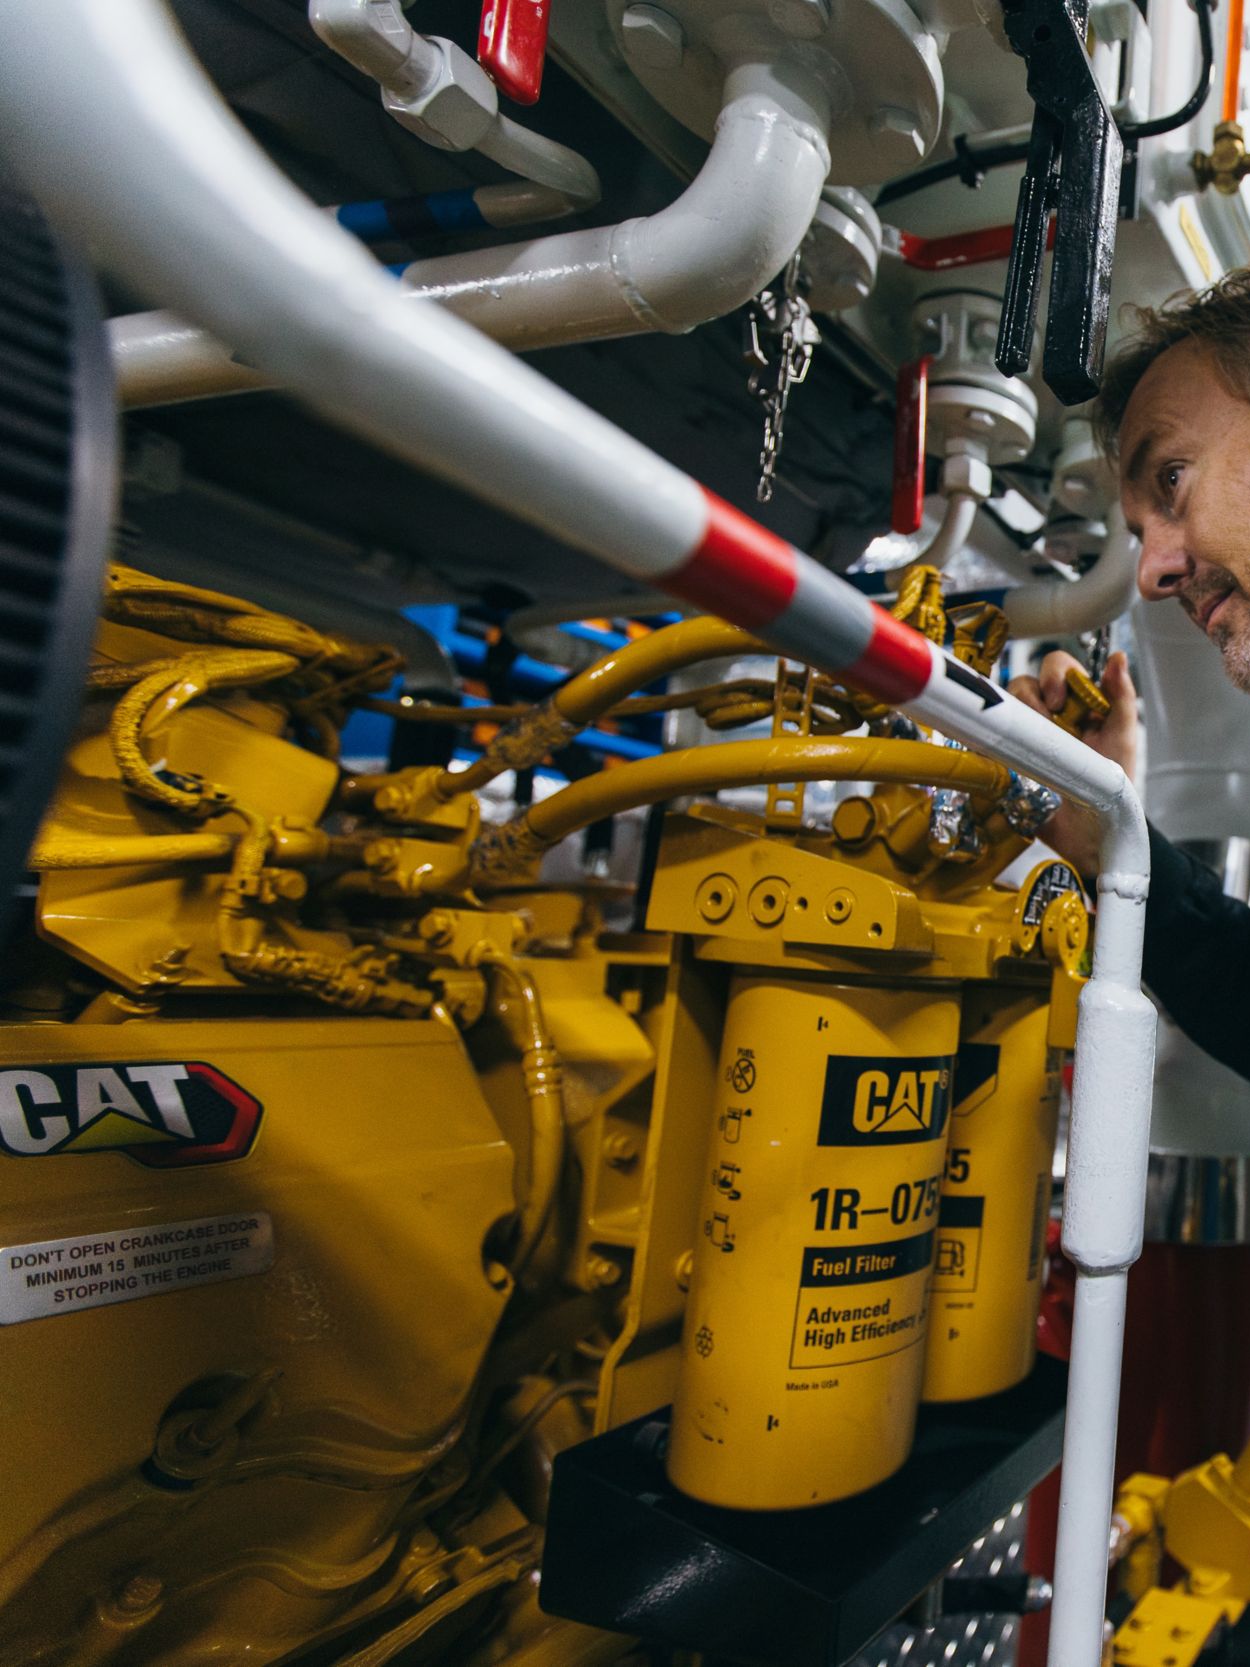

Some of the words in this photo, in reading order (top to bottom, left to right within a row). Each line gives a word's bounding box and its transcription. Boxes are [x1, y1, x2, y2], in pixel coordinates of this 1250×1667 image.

[0, 1064, 196, 1154] CAT
[11, 1249, 65, 1270] DON'T
[69, 1242, 116, 1261] OPEN
[119, 1222, 215, 1251] CRANKCASE
[217, 1217, 259, 1236] DOOR
[26, 1261, 103, 1288] MINIMUM
[108, 1258, 125, 1273] 15
[133, 1244, 201, 1269] MINUTES
[204, 1237, 250, 1257] AFTER
[53, 1275, 138, 1304] STOPPING
[142, 1267, 173, 1287] THE
[176, 1258, 233, 1280] ENGINE
[812, 1257, 850, 1278] Fuel
[855, 1254, 897, 1274] Filter
[803, 1329, 845, 1350] High
[850, 1313, 917, 1343] Efficiency
[806, 1298, 891, 1325] Advanced
[785, 1382, 809, 1391] Made
[811, 1382, 819, 1390] in
[820, 1379, 839, 1389] USA
